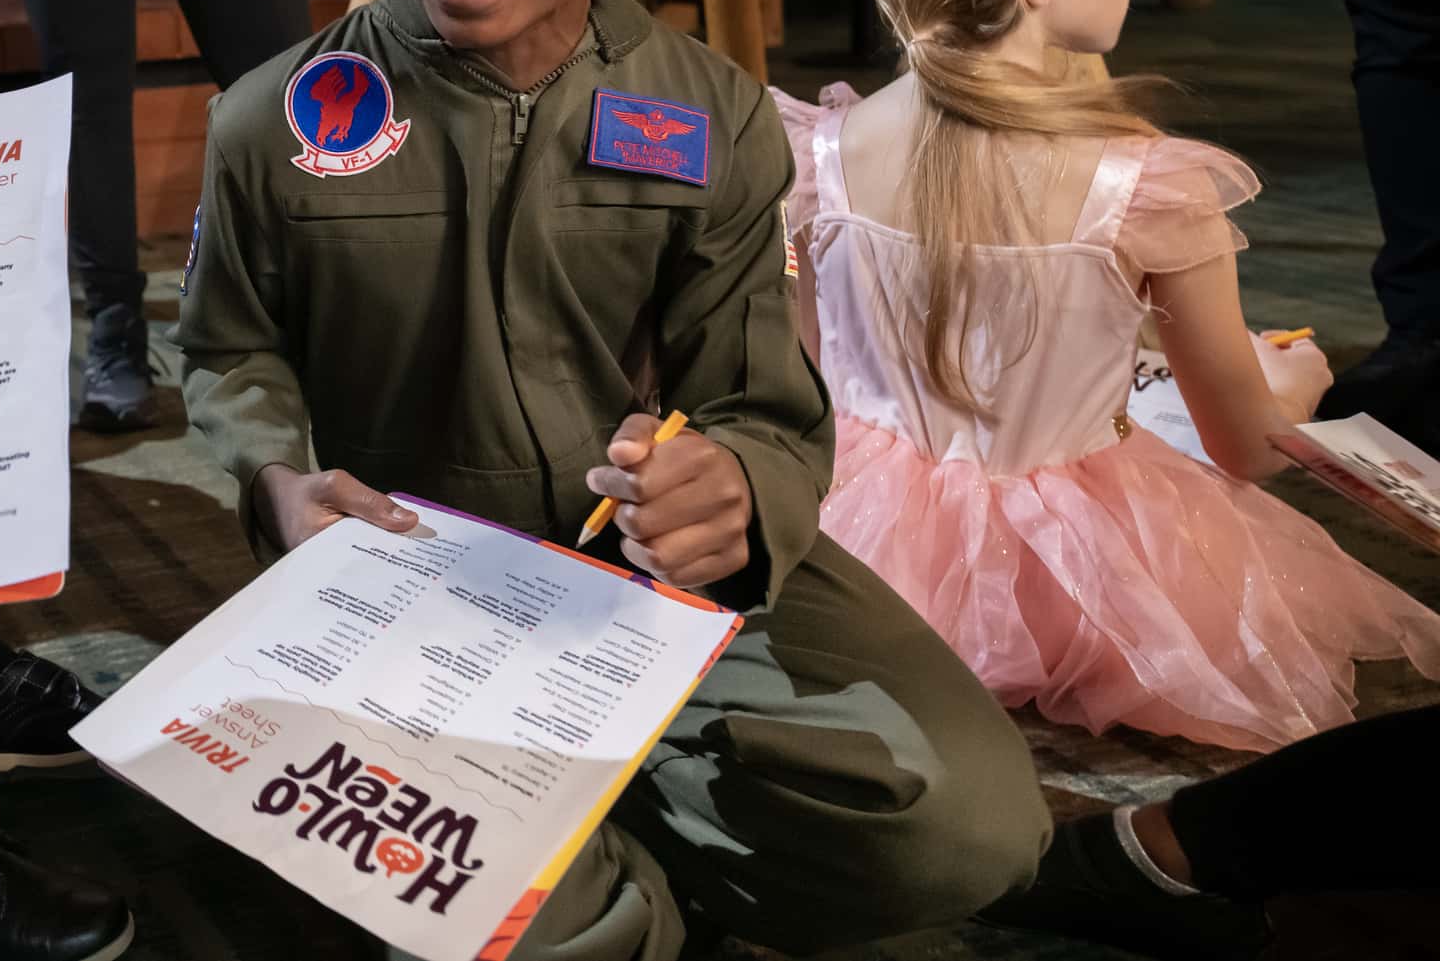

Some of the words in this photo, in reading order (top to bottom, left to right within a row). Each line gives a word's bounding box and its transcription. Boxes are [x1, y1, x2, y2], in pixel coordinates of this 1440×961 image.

[341, 151, 373, 170] VF-1
[190, 704, 268, 749] Answer
[220, 696, 280, 736] Sheet
[159, 717, 250, 773] TRIVIA
